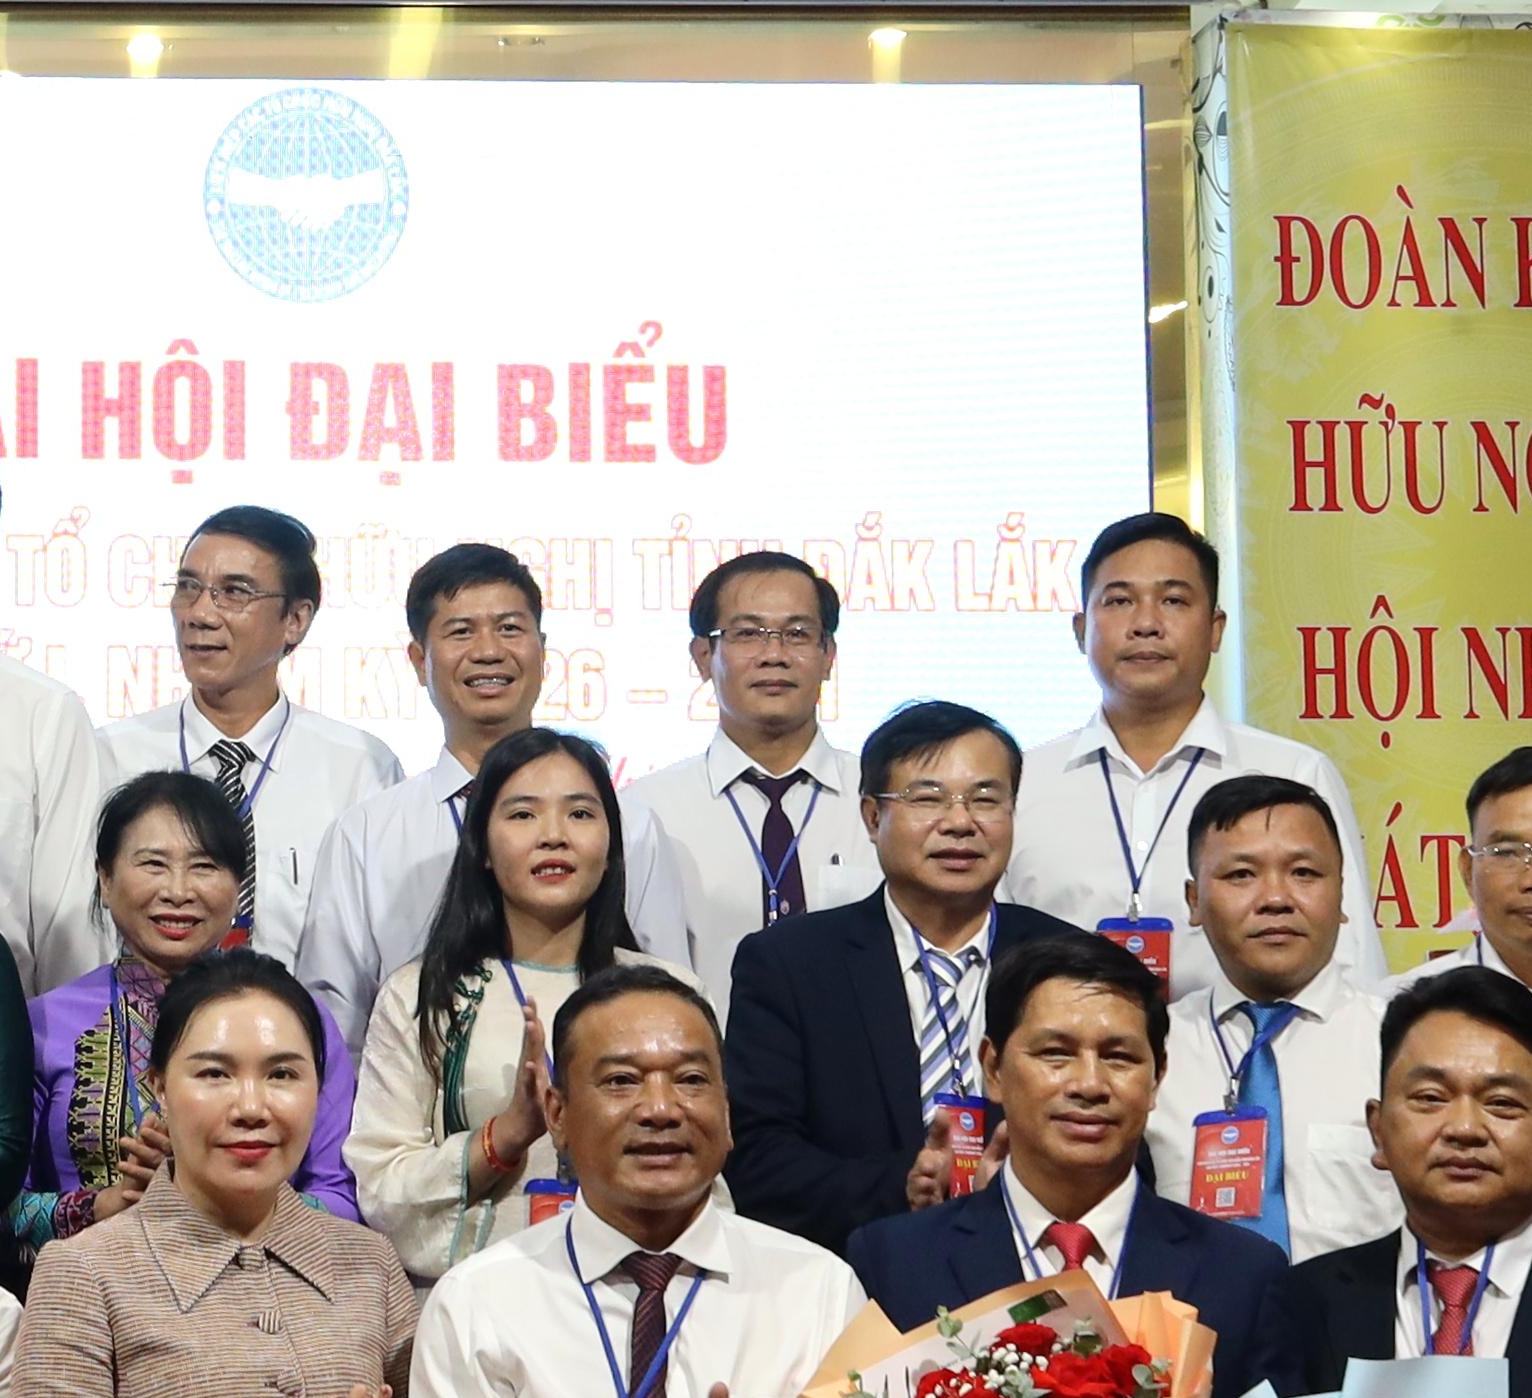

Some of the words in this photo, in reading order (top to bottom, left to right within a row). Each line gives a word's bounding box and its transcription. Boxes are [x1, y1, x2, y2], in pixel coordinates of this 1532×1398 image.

[1273, 184, 1487, 310] ĐOÀN
[81, 338, 246, 485] HỘI
[284, 360, 456, 486] ĐẠI
[497, 319, 728, 465] BIỂU
[1286, 393, 1449, 516] HỮU
[6, 506, 91, 608] TỔ
[954, 512, 1080, 612] LẮK
[1298, 594, 1438, 749] HỘI
